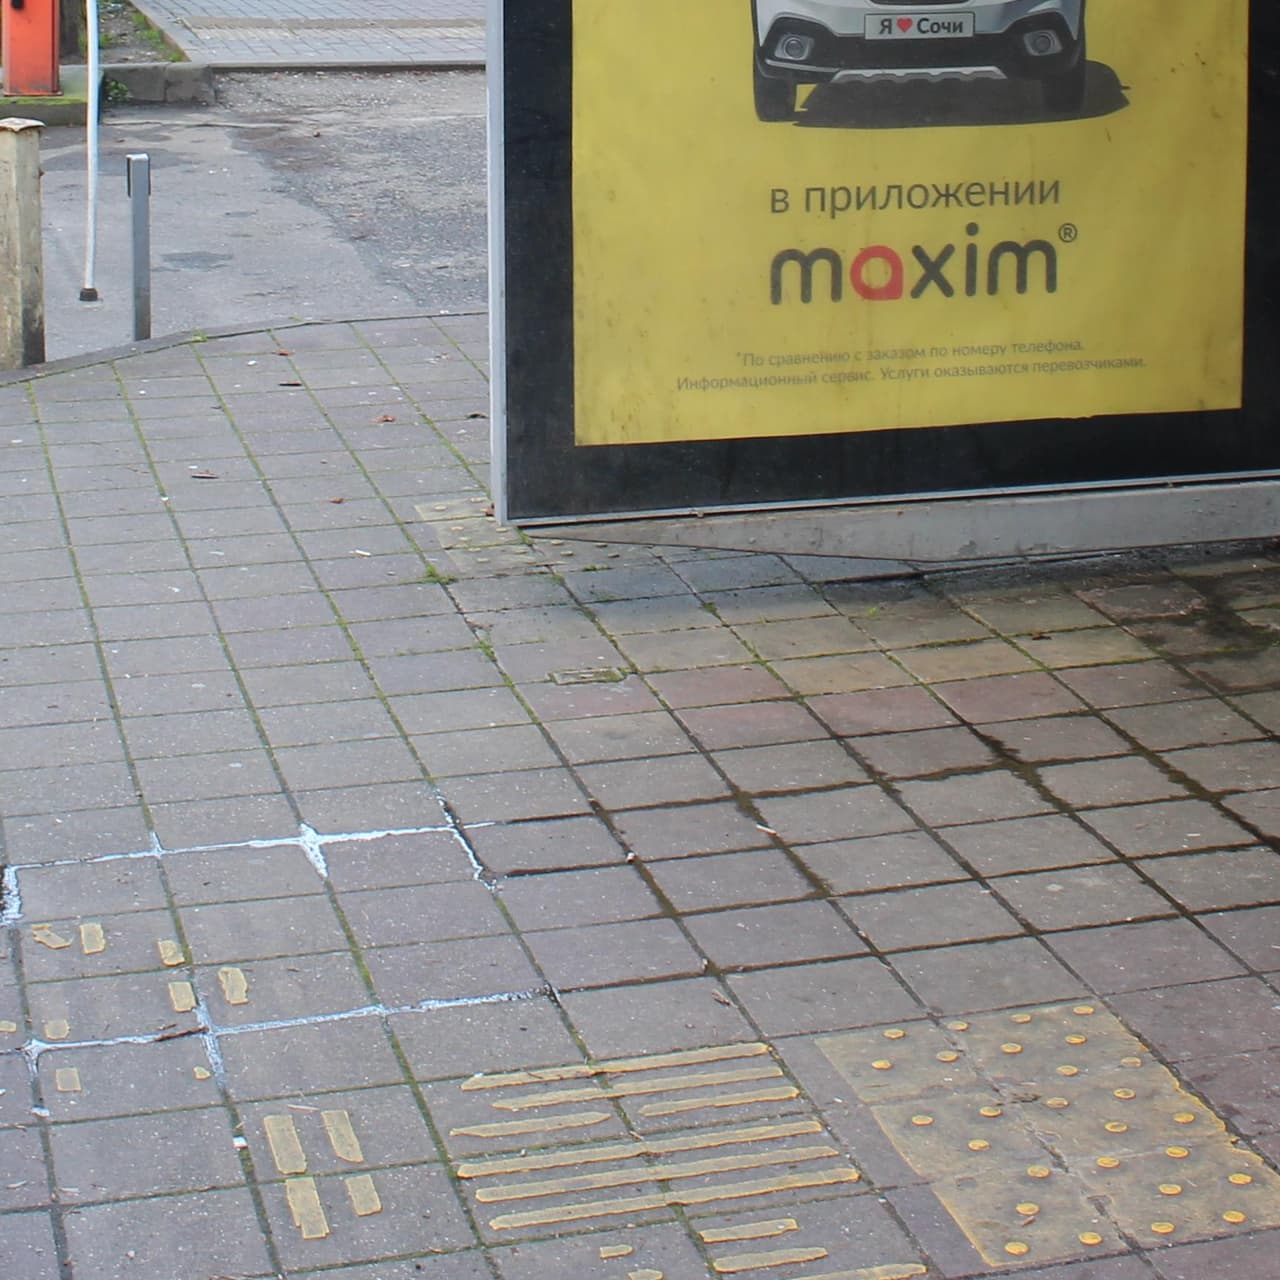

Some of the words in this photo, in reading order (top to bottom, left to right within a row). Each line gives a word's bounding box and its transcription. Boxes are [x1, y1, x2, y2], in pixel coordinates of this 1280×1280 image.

[878, 18, 893, 35] Я
[916, 17, 964, 36] Сочи
[770, 188, 790, 214] в
[804, 179, 1061, 220] приложении
[767, 351, 850, 368] сравнению
[854, 350, 862, 362] с
[866, 347, 925, 362] заказом
[929, 347, 948, 357] по
[952, 343, 1008, 360] номеру
[1012, 339, 1084, 356] телефона.
[676, 372, 818, 393] Информационный
[880, 366, 931, 382] Услуги
[934, 362, 1029, 379] оказываются
[1032, 356, 1147, 375] перевозчиками.
